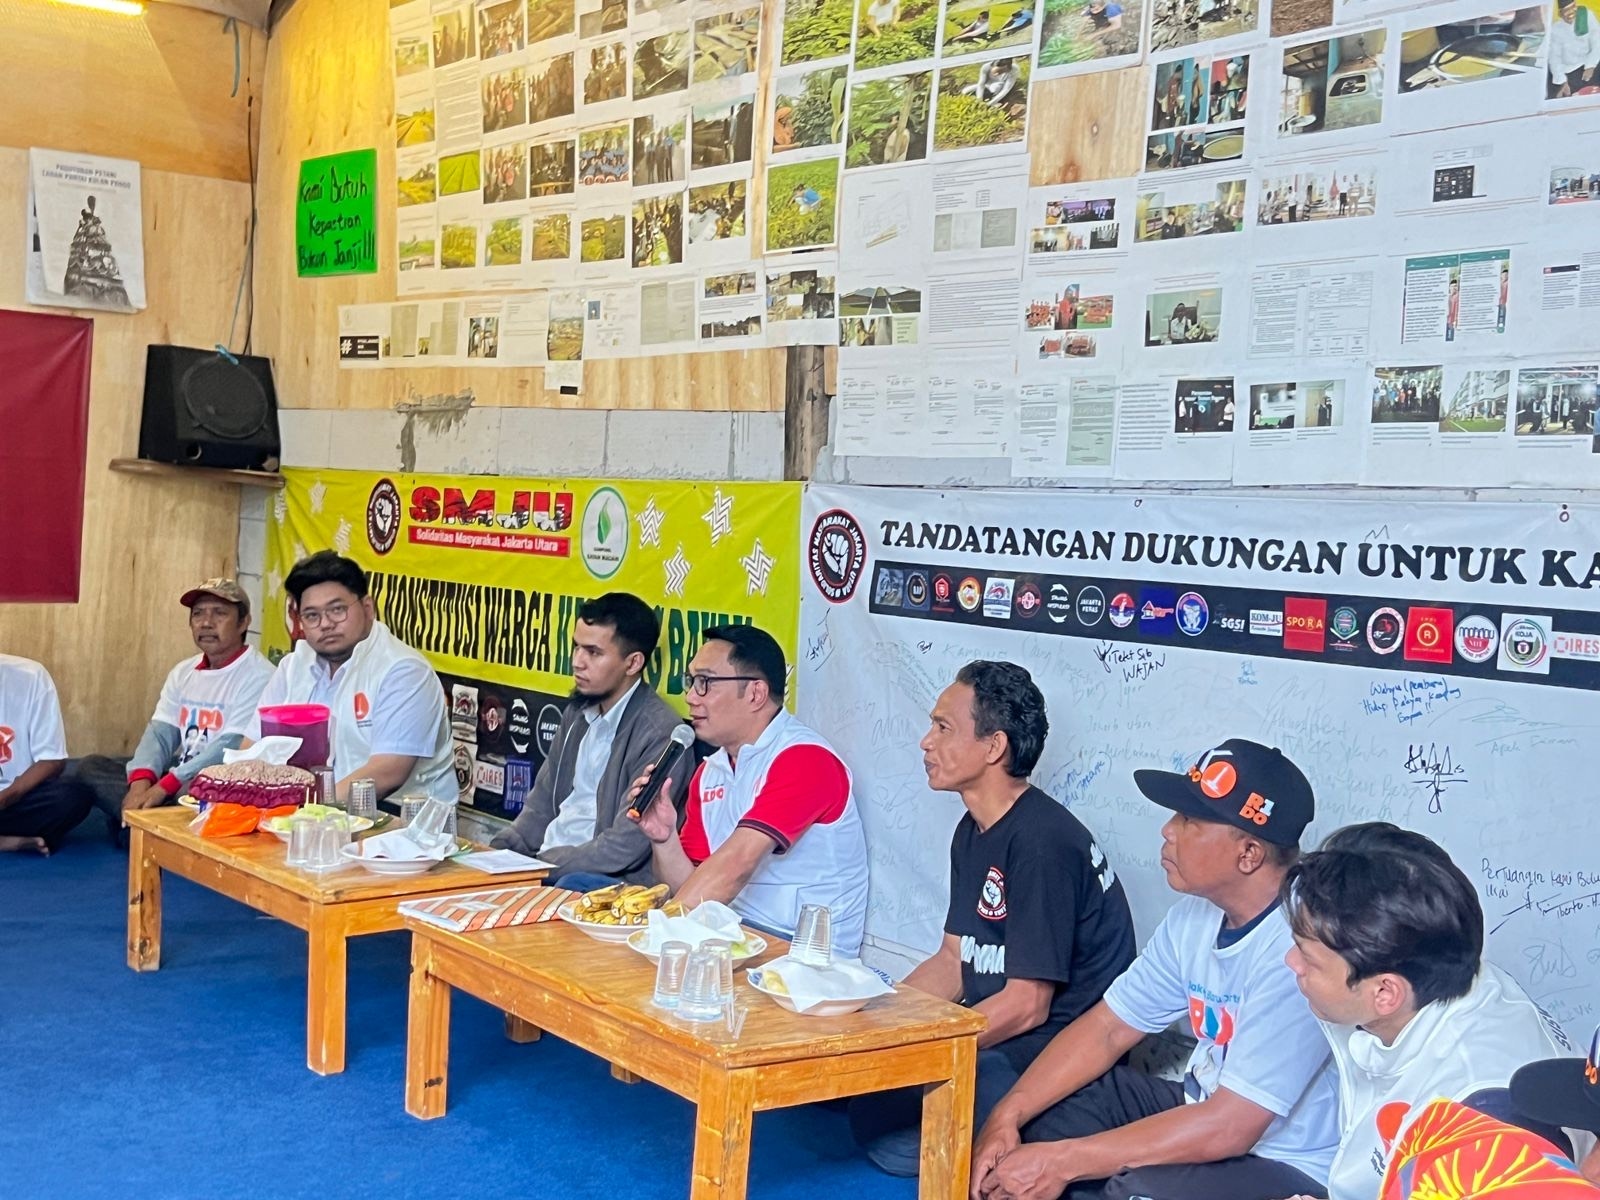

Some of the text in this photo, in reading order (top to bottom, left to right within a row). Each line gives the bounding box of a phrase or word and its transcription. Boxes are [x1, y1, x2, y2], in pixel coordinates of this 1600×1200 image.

[409, 486, 574, 532] SMJU
[416, 528, 559, 552] Solidaritas Masyarakat Jakarta Utara
[880, 520, 1116, 560] TANDATANGAN
[1122, 532, 1347, 575] DUKUNGAN
[1358, 543, 1527, 585] UNTUK
[384, 573, 483, 660] KONSTITUSI
[484, 586, 553, 671] WARGA
[1221, 617, 1245, 631] SGSI
[1251, 612, 1282, 623] KOM-JU
